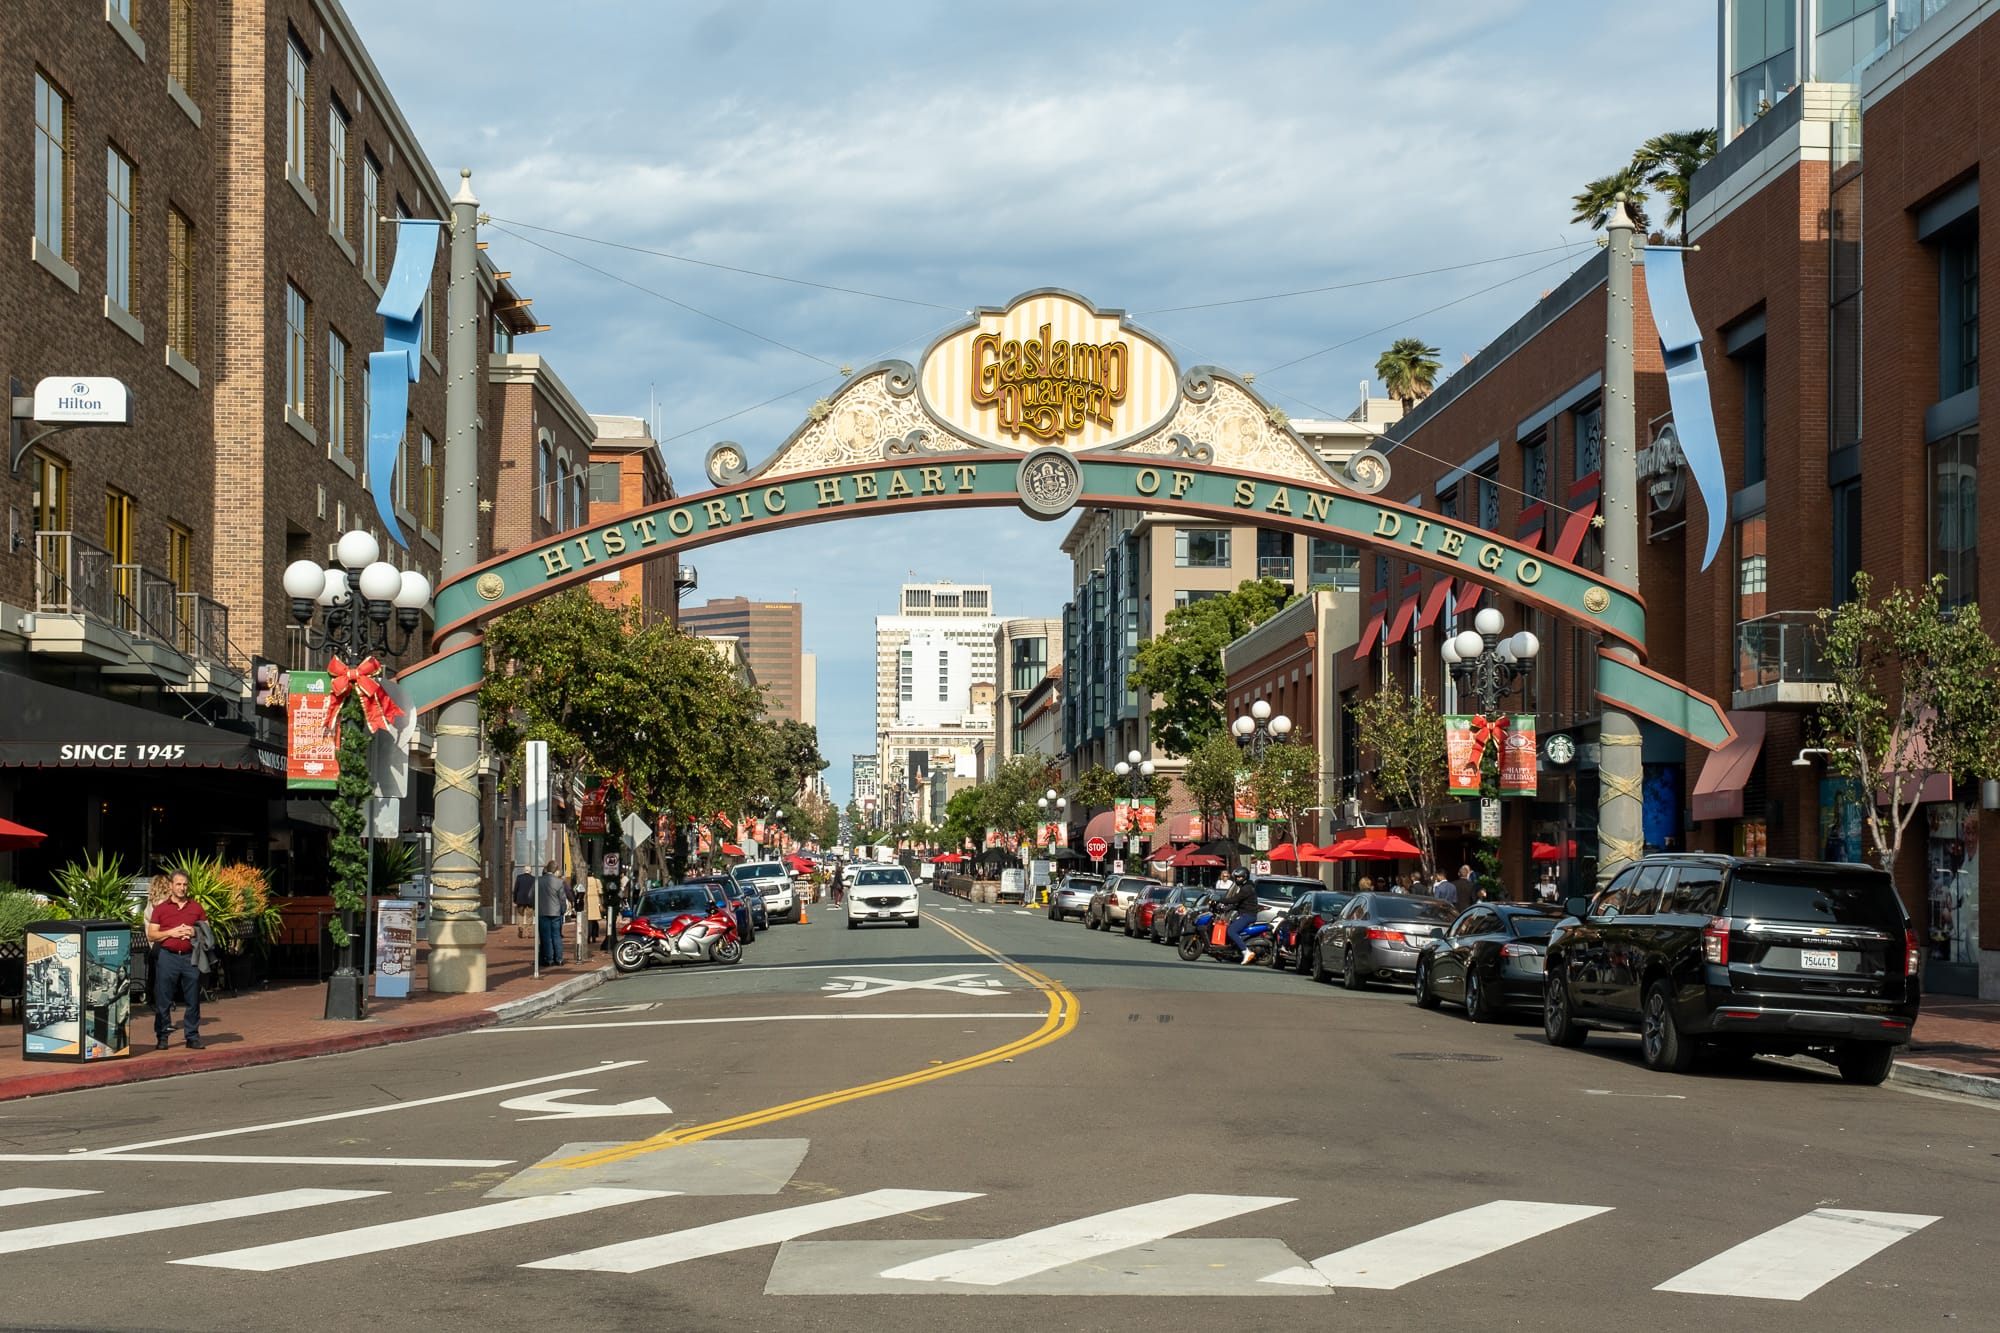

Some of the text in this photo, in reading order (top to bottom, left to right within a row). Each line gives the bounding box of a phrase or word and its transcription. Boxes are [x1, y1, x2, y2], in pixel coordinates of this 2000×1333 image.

[971, 323, 1128, 402] Gaslamp
[58, 397, 102, 409] Hilton
[998, 379, 1114, 437] Quarter
[539, 486, 787, 577] HISTORIC
[814, 465, 978, 506] HEART
[1135, 468, 1196, 498] OF
[1233, 480, 1333, 521] SAN
[1373, 509, 1543, 585] DIEGO
[60, 744, 186, 761] SINCE 1945
[258, 749, 280, 770] FAMOUS
[1088, 843, 1106, 852] STOP
[1803, 956, 1836, 968] 75444T2
